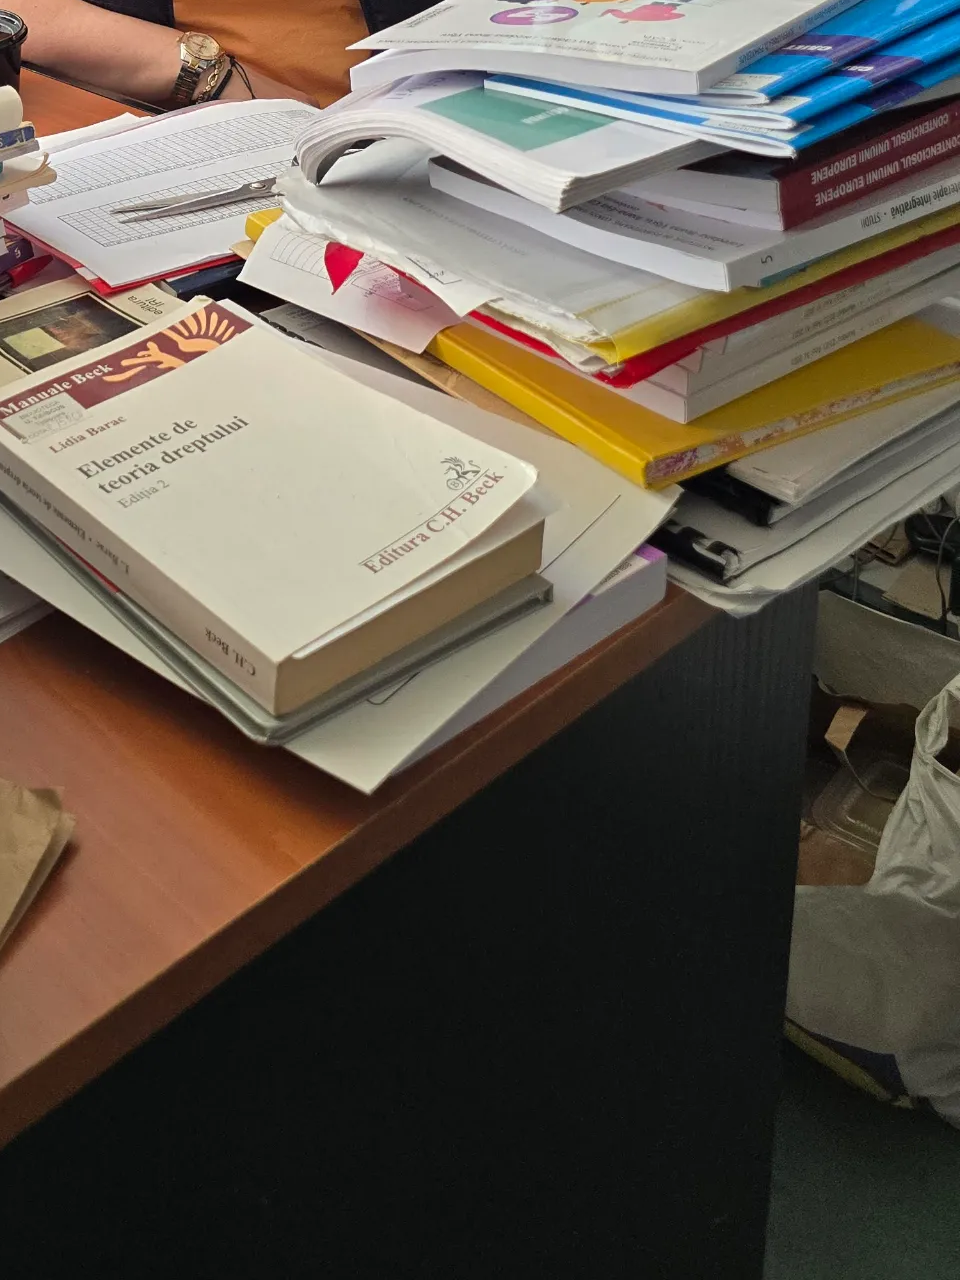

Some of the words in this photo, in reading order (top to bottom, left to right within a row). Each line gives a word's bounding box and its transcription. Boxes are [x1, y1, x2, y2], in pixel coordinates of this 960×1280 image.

[890, 112, 949, 148] CONTENCIOSUL
[858, 138, 889, 162] UNIUNII
[810, 153, 856, 185] EUROPENE
[866, 160, 899, 184] UNIUNII
[814, 174, 864, 207] EUROPENE
[890, 195, 932, 223] integrativă
[128, 295, 163, 316] editura
[145, 298, 165, 307] IRI
[71, 362, 114, 386] Beck
[48, 433, 87, 455] Lidia
[85, 414, 128, 438] Barac
[76, 428, 173, 479] Elemente
[171, 417, 199, 436] de
[97, 454, 161, 494] teoria
[159, 415, 250, 465] dreptului
[154, 478, 170, 492] 2
[42, 497, 52, 512] de
[52, 504, 86, 540] Elemente
[363, 532, 430, 574] Editura
[426, 506, 467, 532] C.H.
[460, 471, 504, 505] Beck
[204, 628, 230, 657] Beck
[232, 648, 257, 677] C.H.
